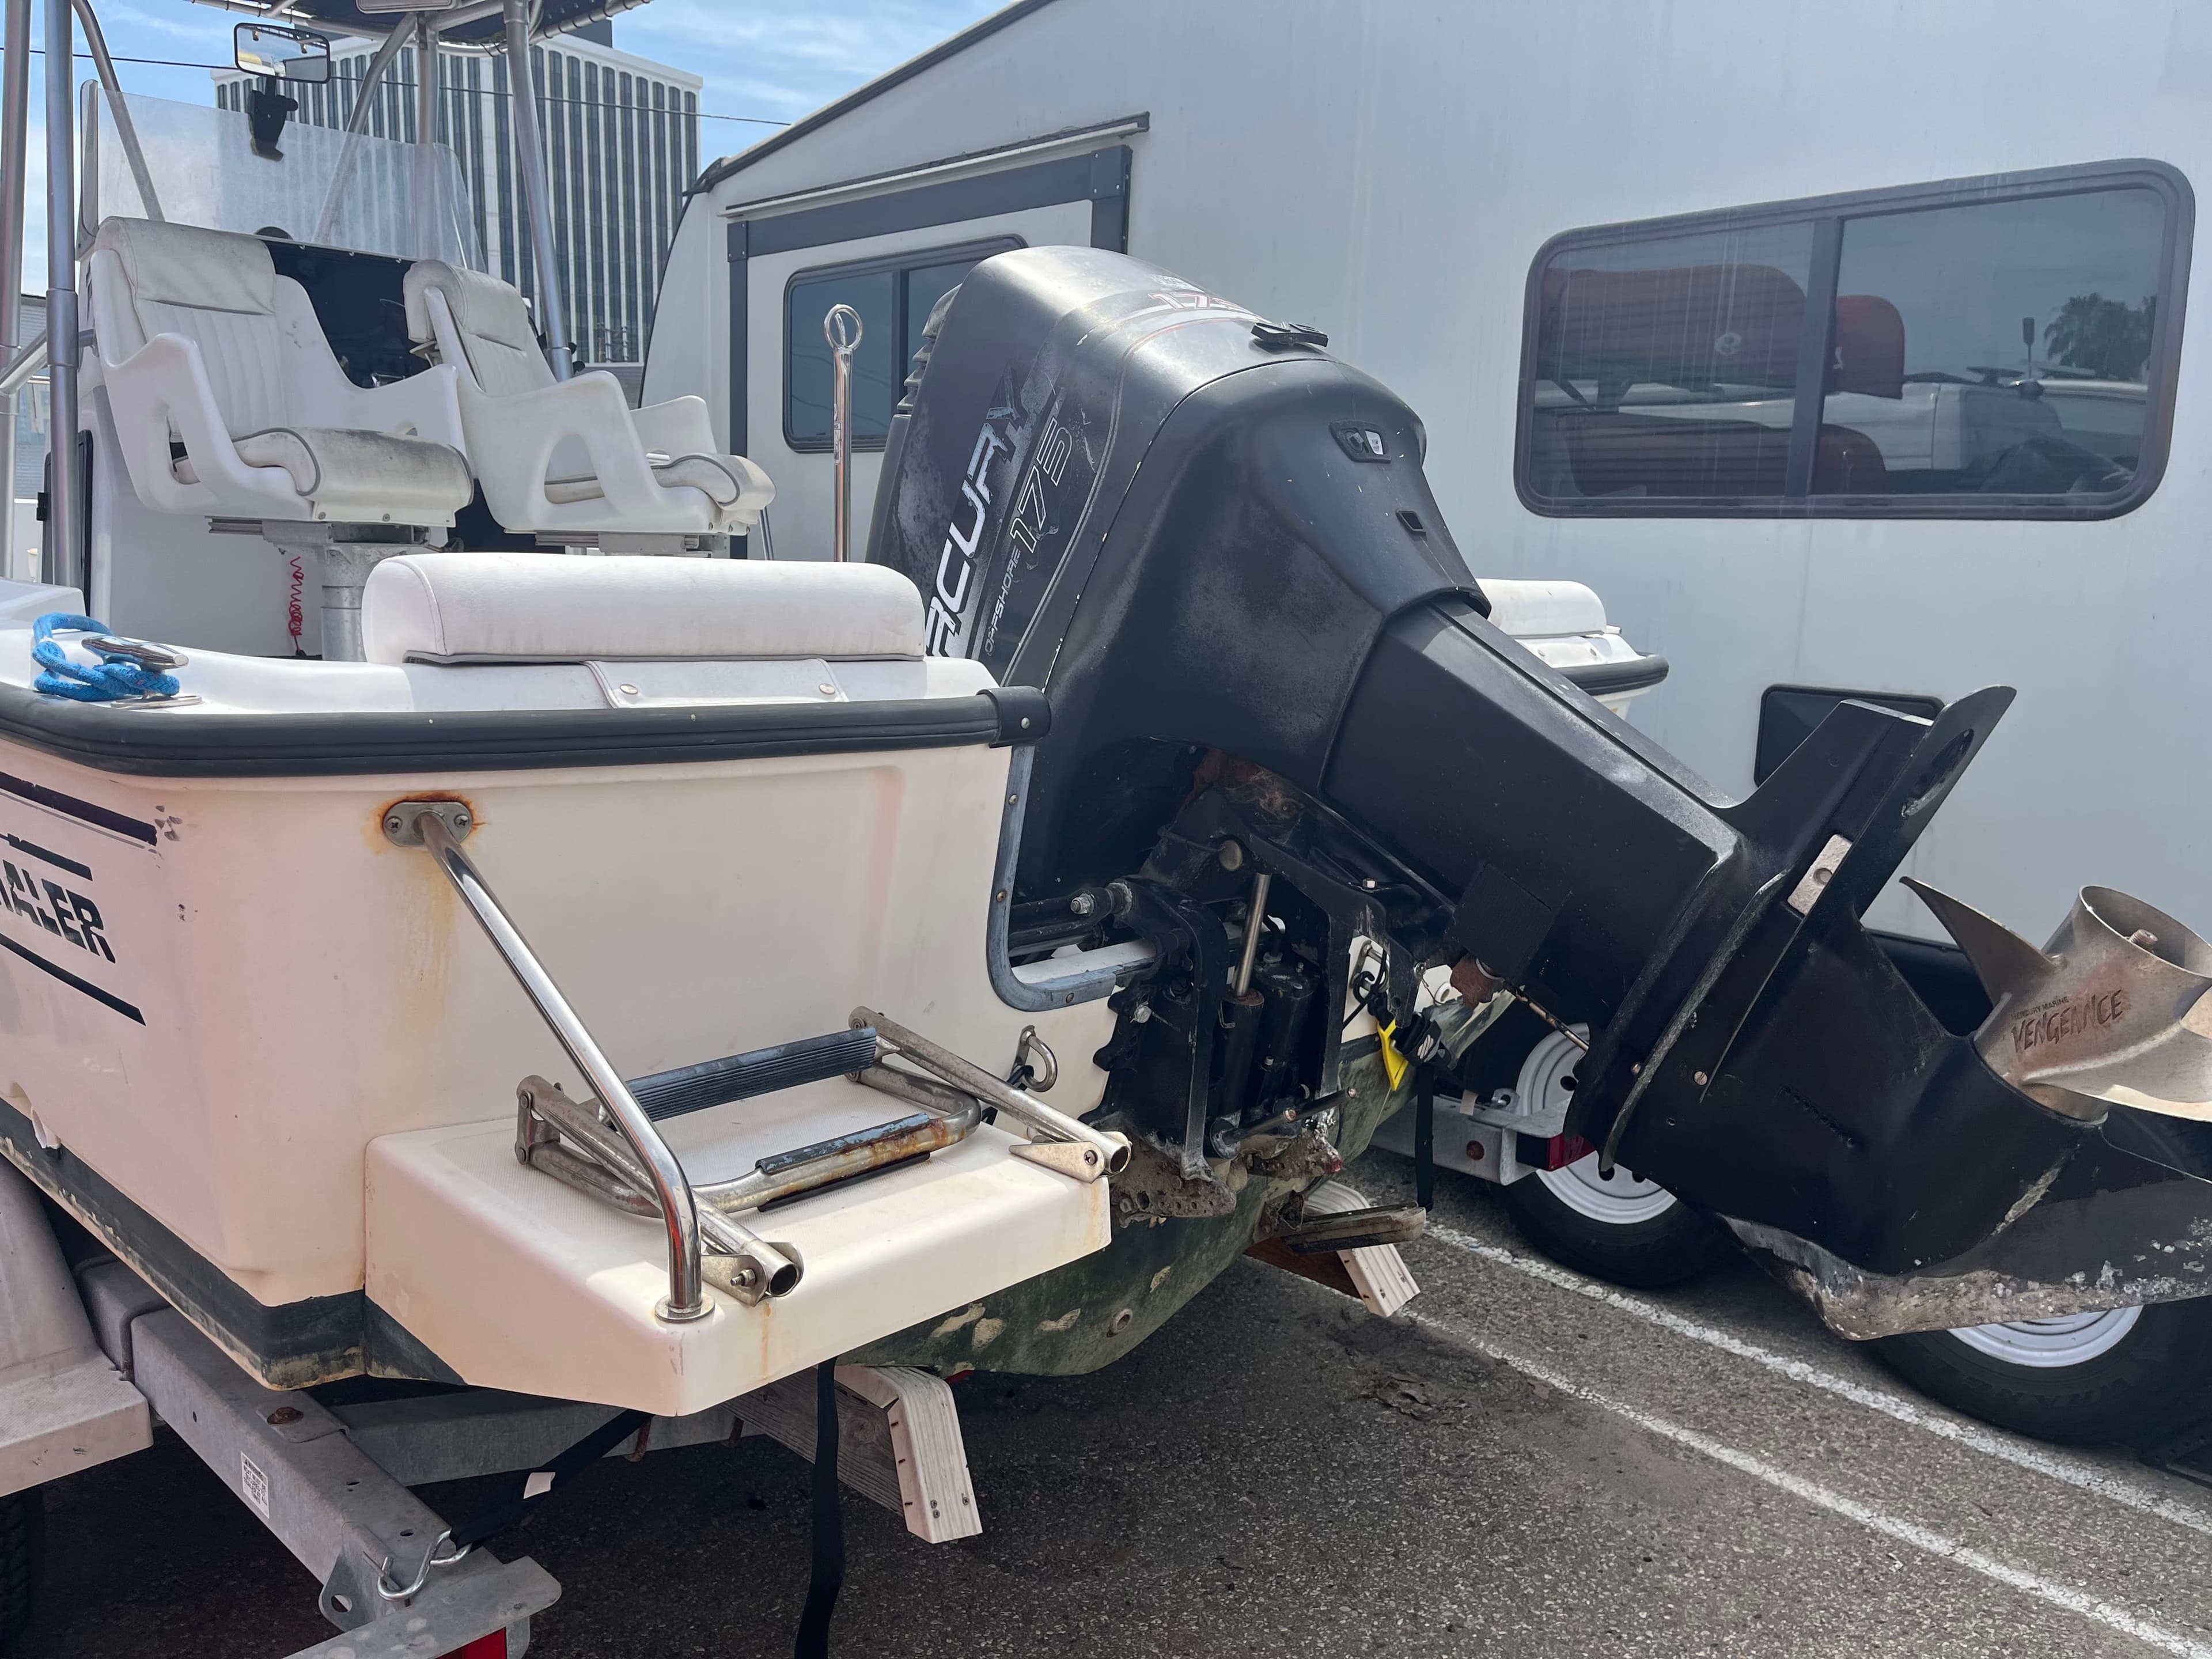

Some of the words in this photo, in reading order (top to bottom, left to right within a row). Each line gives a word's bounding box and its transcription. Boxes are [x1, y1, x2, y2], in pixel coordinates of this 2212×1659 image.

[1009, 415, 1074, 554] 175
[983, 544, 1022, 656] OFFSHORE
[2010, 989, 2123, 1052] VENGEANCE
[2041, 996, 2070, 1010] MARINE
